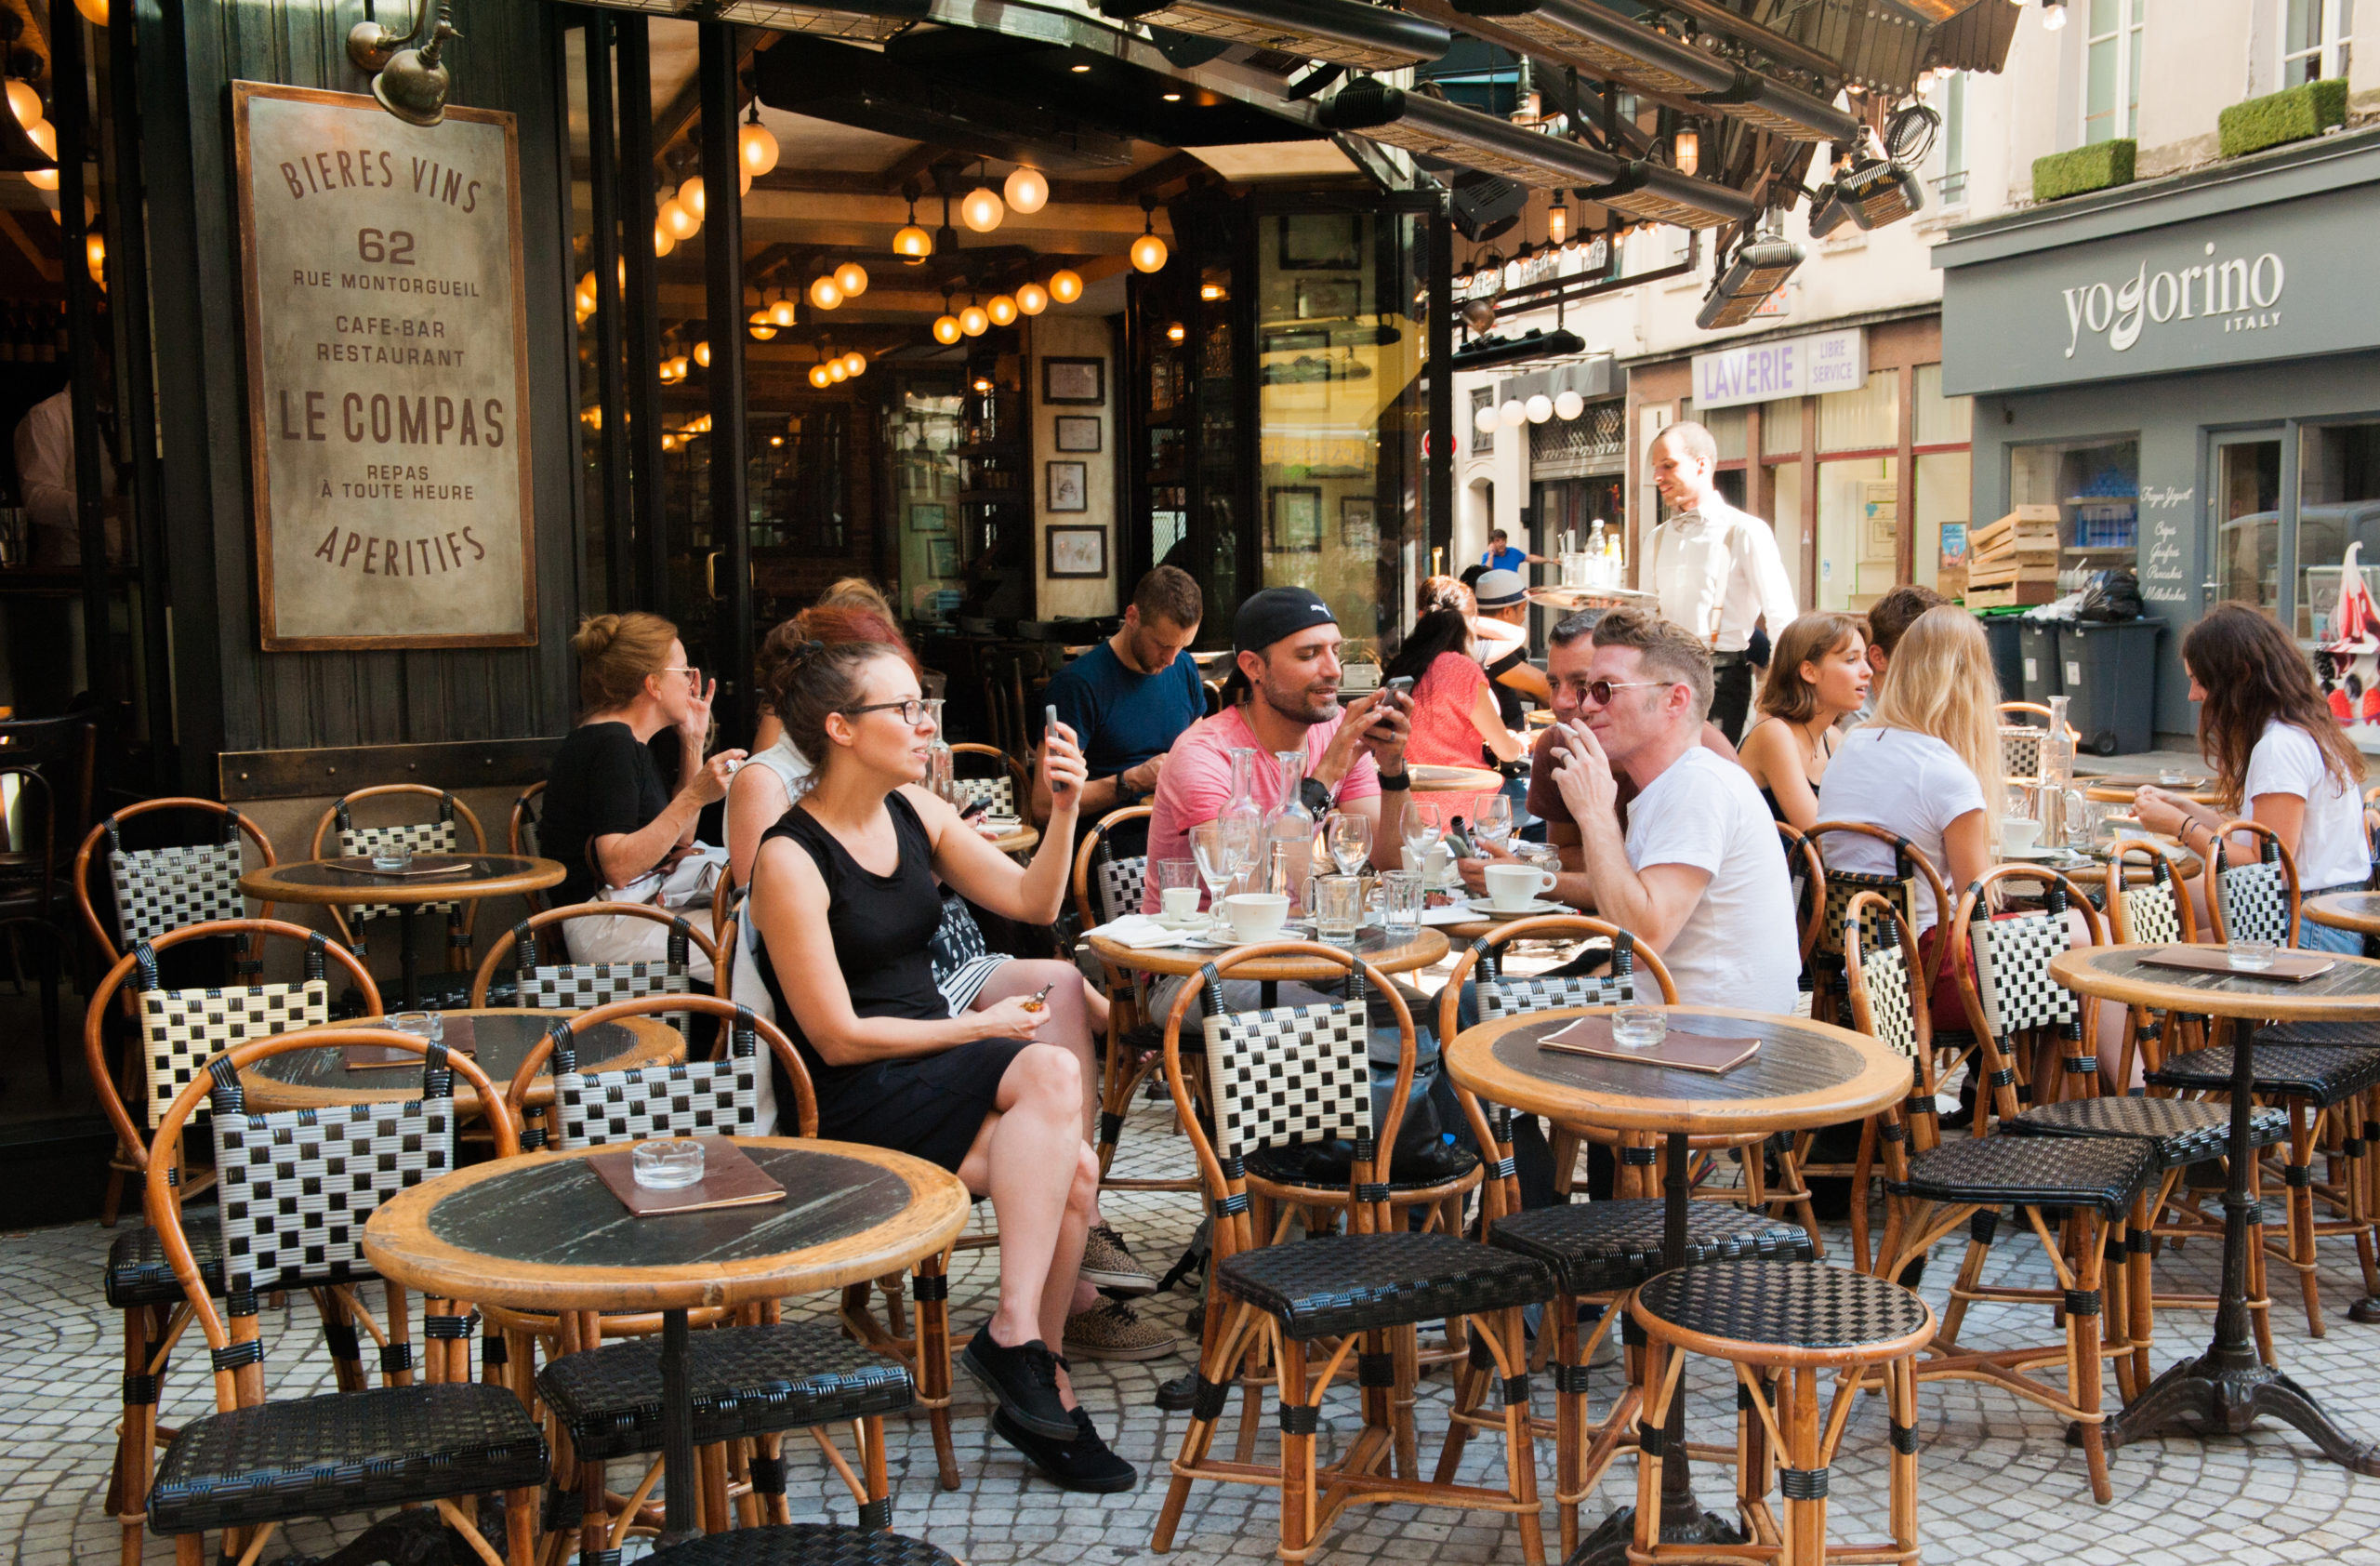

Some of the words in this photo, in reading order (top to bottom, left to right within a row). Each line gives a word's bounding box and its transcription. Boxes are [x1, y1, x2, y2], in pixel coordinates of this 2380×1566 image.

[280, 150, 392, 200] BIERES
[412, 156, 482, 214] VINS
[358, 228, 416, 265] 62
[293, 269, 332, 287] RUE
[341, 273, 480, 298] MONTORGUEIL
[2061, 242, 2284, 359] yogorino
[336, 314, 445, 338] CAFE-BAR
[2225, 312, 2282, 333] ITALY
[317, 343, 465, 367] RESTAURANT
[1819, 339, 1845, 359] LIBRE
[1704, 346, 1792, 400] LAVERIE
[1813, 362, 1853, 383] SERVICE
[280, 390, 326, 441] LE
[343, 392, 504, 448] COMPAS
[367, 465, 430, 481] REPAS
[321, 479, 333, 498] À
[342, 483, 403, 499] TOUTE
[413, 484, 474, 500] HEURE
[314, 525, 485, 577] APERITIFS
